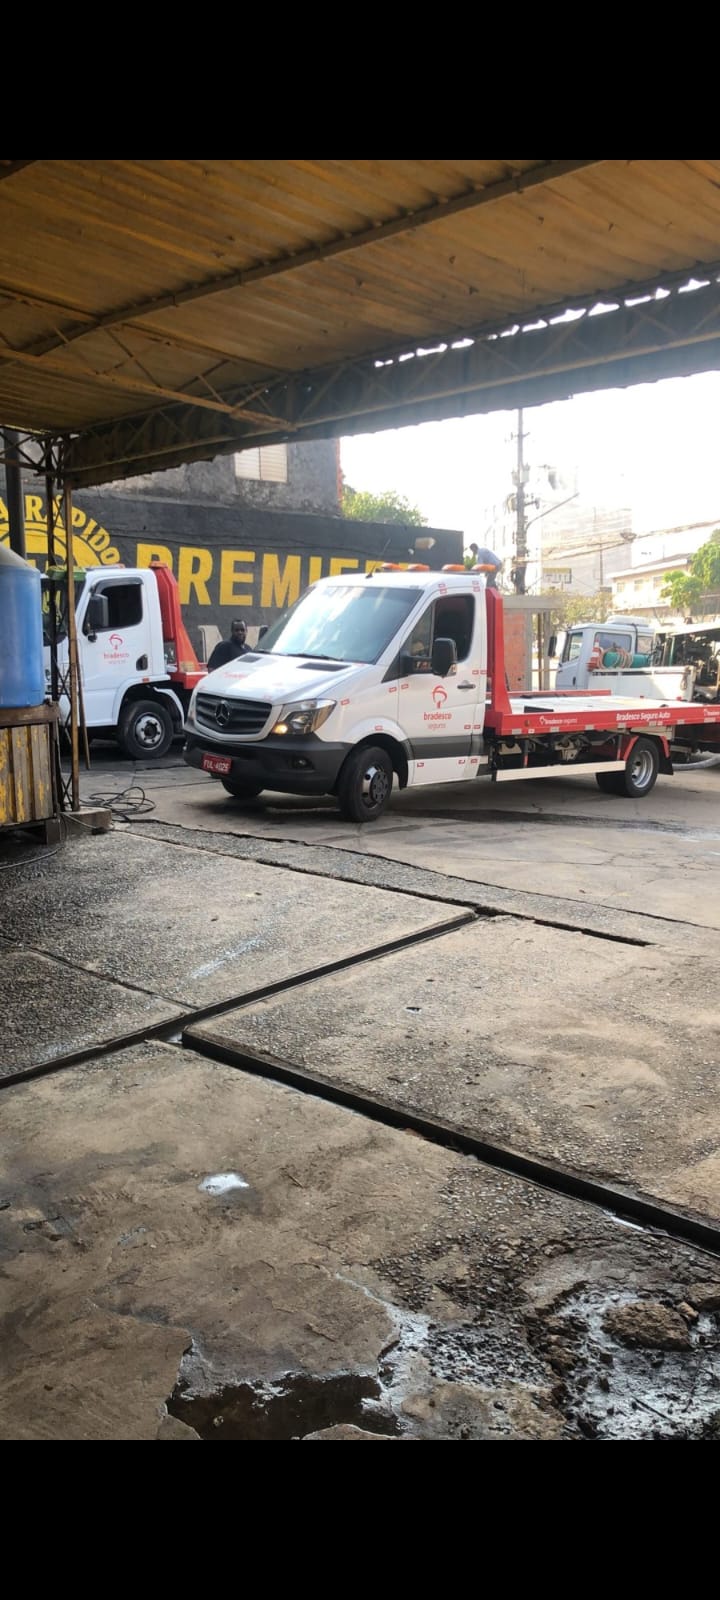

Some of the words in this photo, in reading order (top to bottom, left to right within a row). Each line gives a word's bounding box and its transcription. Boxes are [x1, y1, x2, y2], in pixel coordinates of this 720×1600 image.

[423, 711, 452, 721] bradesco
[616, 713, 640, 721] Bradesco
[640, 712, 658, 721] Seguro
[658, 711, 671, 719] Auto
